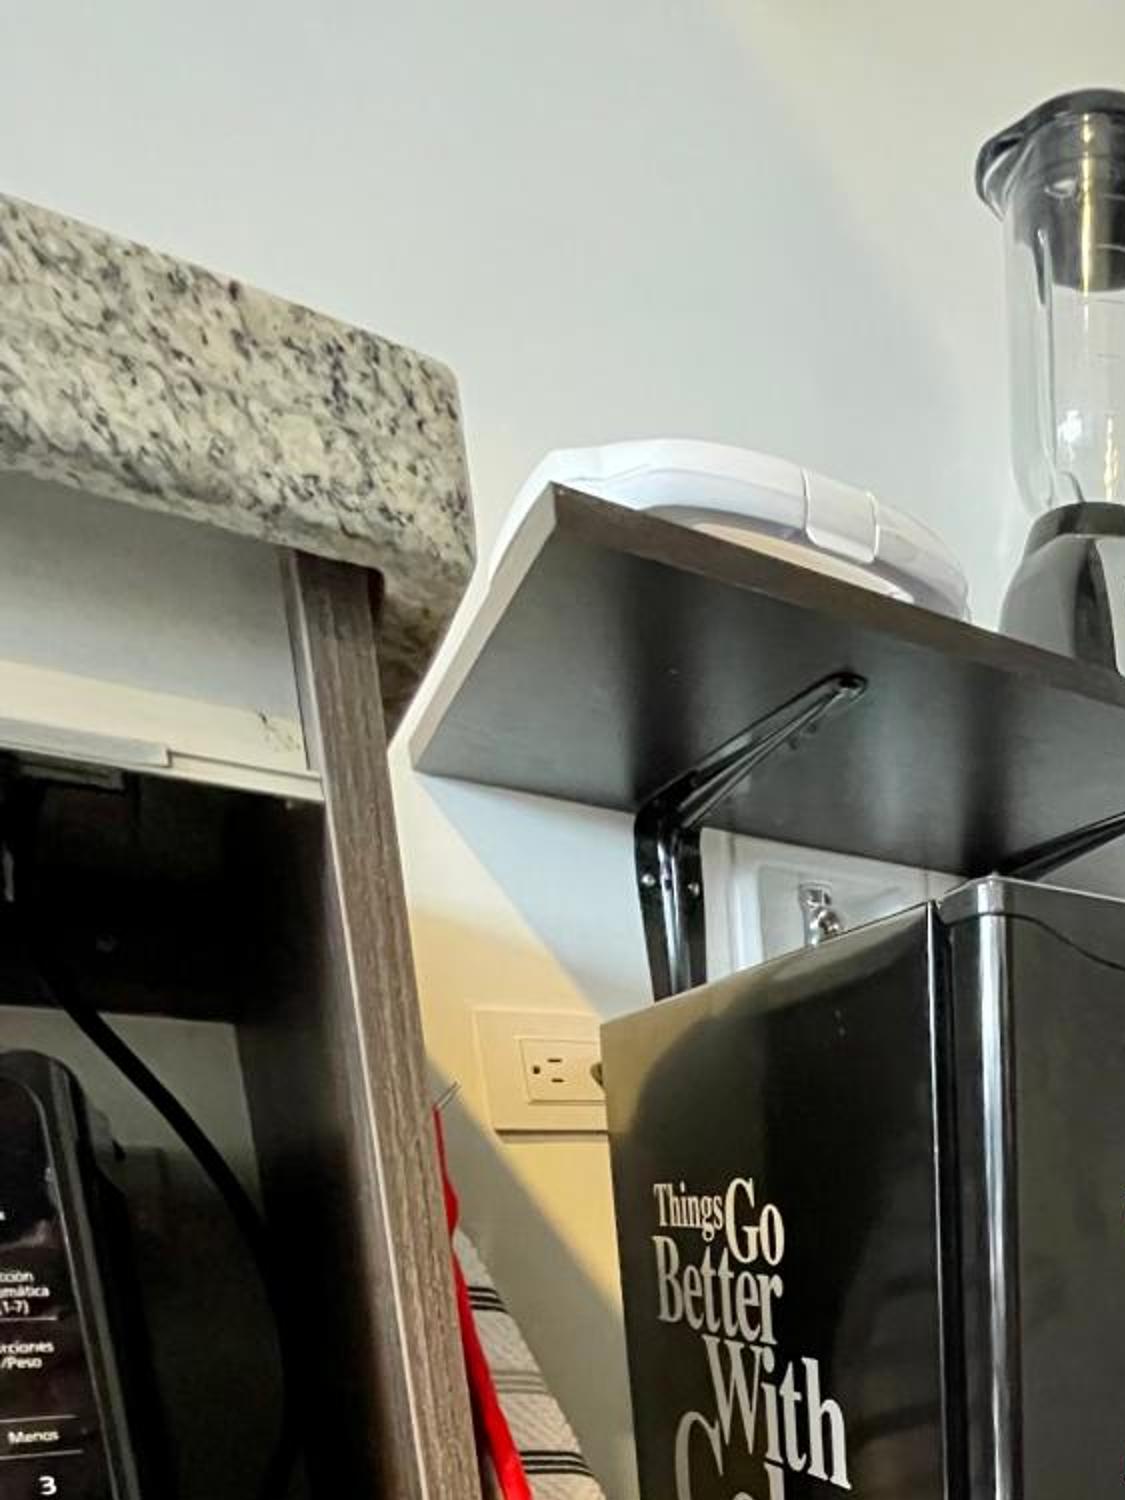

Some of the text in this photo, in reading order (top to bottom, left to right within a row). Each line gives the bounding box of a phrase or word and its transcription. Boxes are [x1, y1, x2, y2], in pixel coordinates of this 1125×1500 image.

[653, 1177, 785, 1266] Things Go
[652, 1235, 784, 1345] Better
[0, 1341, 55, 1355] rciones
[7, 1431, 59, 1444] Menos
[702, 1334, 852, 1490] With
[39, 1475, 57, 1496] 3
